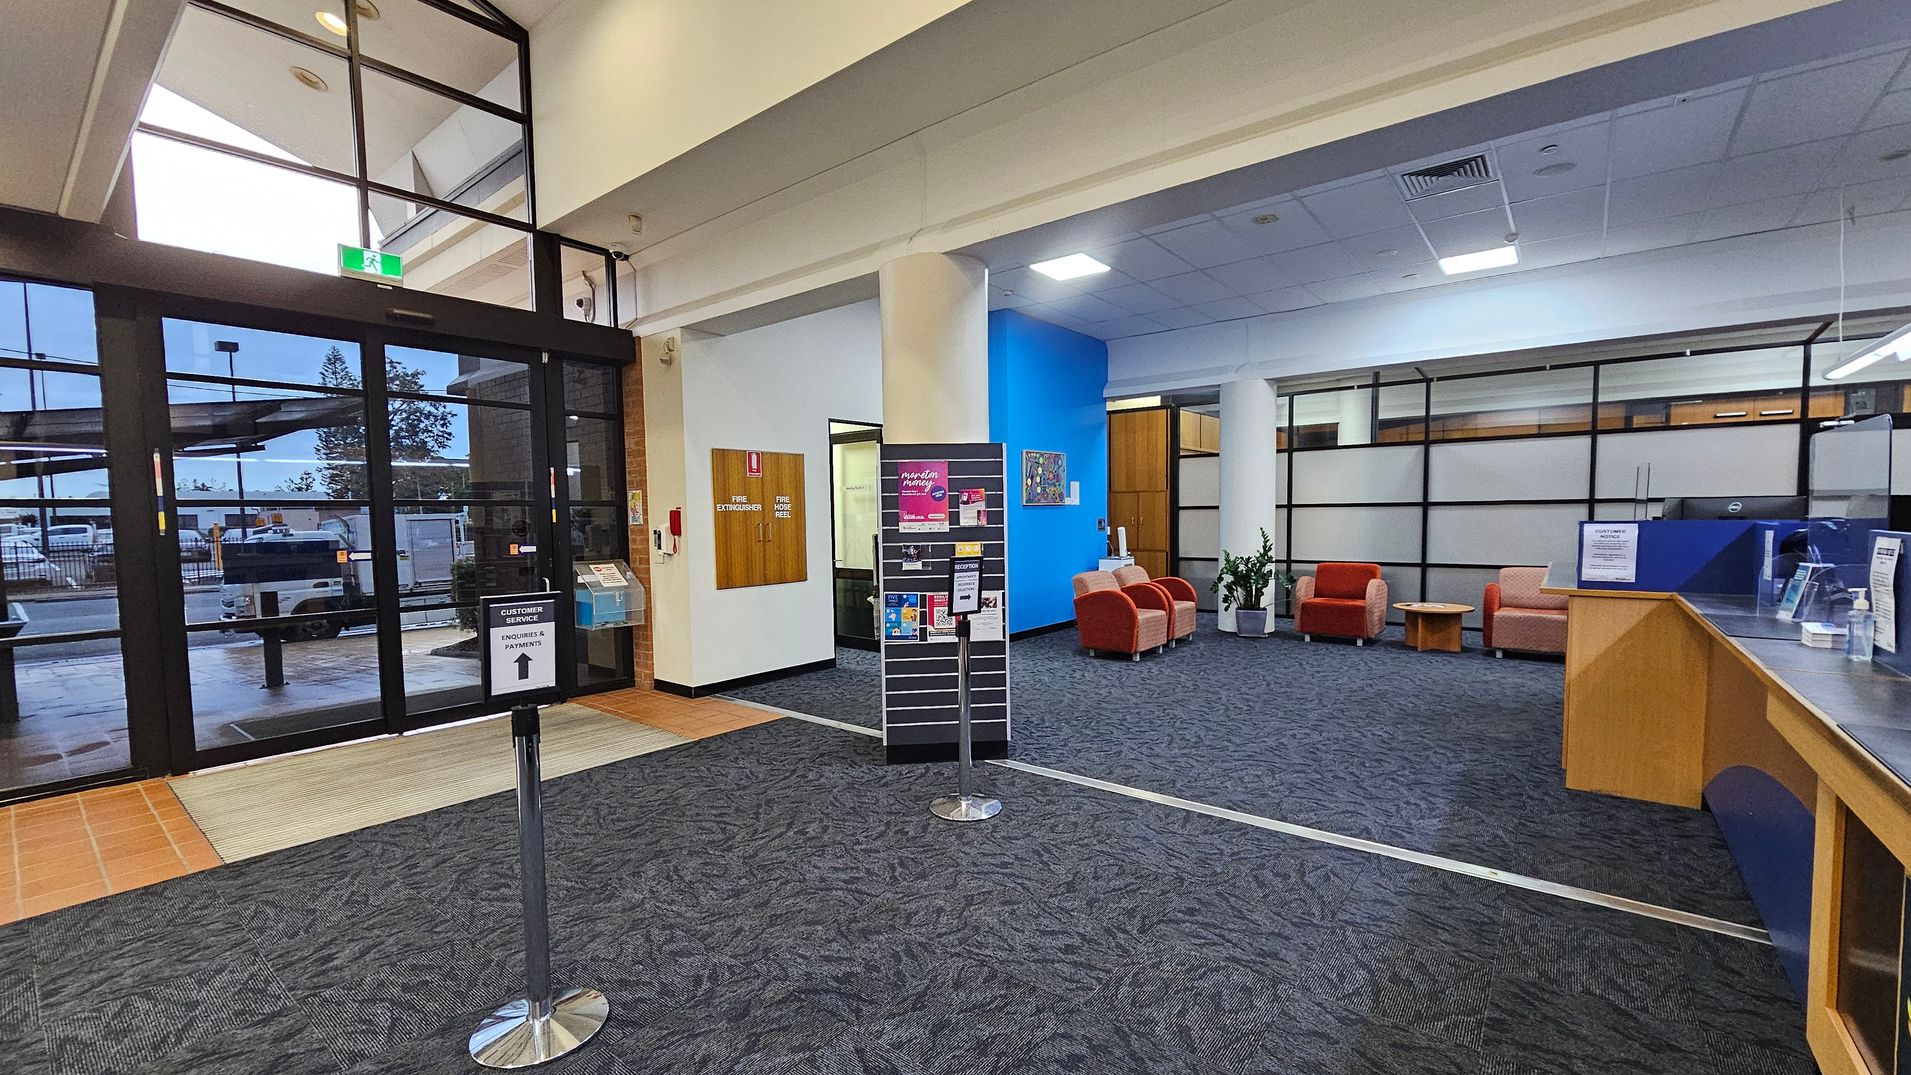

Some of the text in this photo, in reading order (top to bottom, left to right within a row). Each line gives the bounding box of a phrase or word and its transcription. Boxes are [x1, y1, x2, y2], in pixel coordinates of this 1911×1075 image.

[901, 469, 939, 480] moreton
[902, 479, 936, 493] money
[731, 495, 748, 503] FIRE
[776, 495, 790, 503] FIRE
[716, 503, 762, 511] EXTINGUISHER
[774, 503, 792, 511] HOSE
[500, 606, 544, 616] CUSTOMER
[505, 614, 539, 624] SERVICE
[501, 630, 538, 641] ENQUIRIES
[504, 640, 542, 650] PAYMENTS
